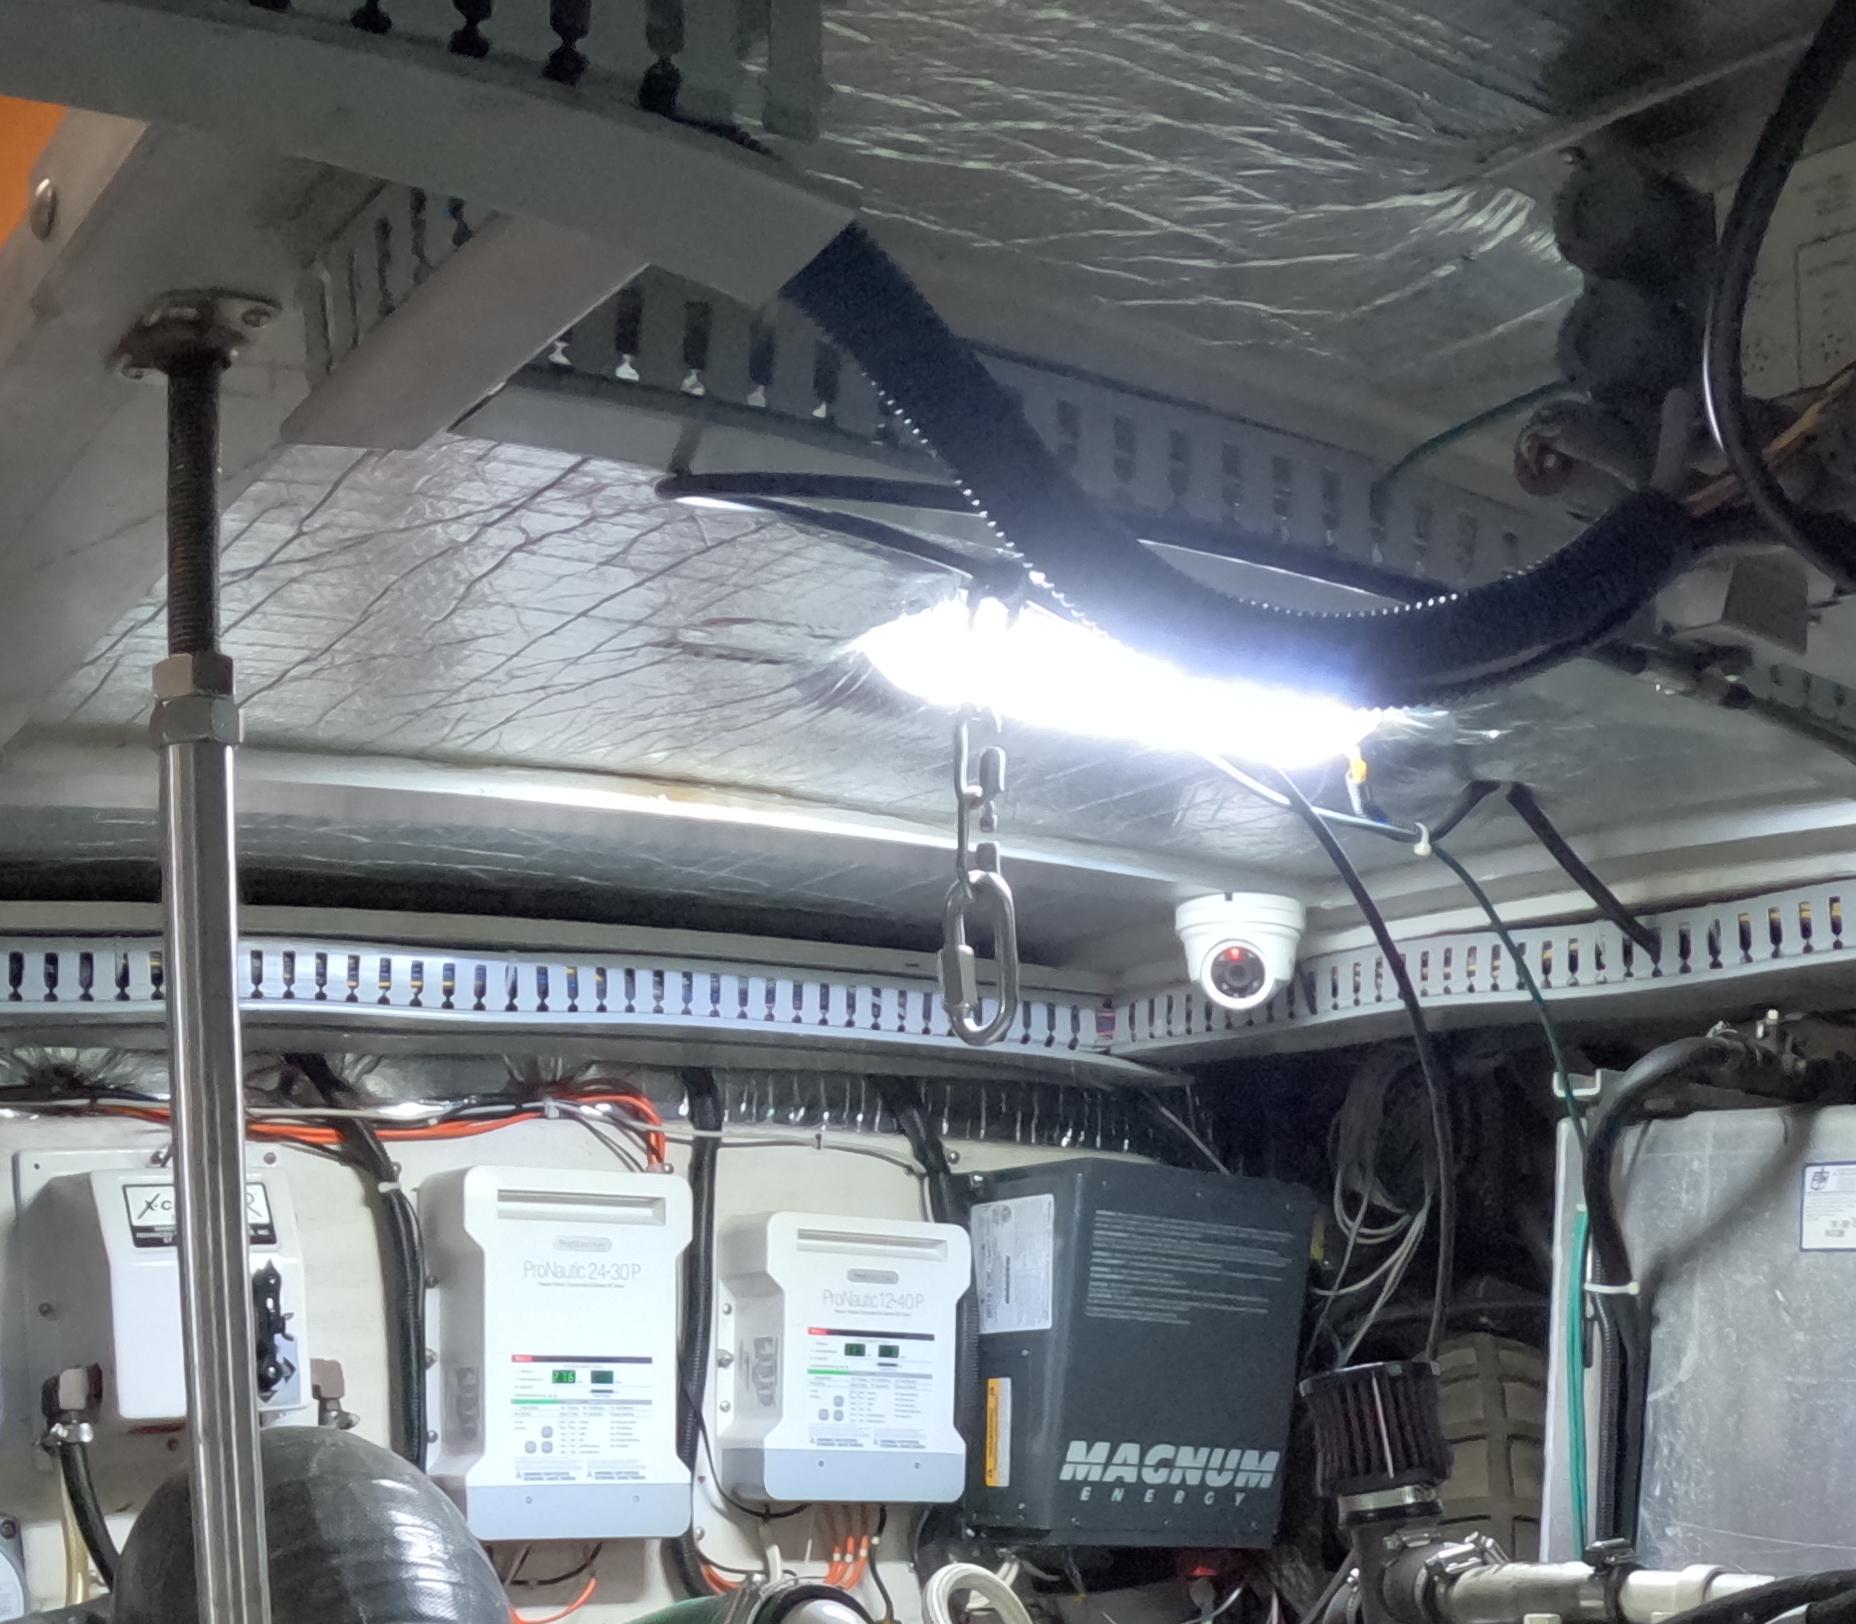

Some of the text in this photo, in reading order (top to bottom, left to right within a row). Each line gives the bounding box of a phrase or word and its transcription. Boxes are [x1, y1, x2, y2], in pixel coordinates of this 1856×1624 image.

[523, 1259, 585, 1279] ProNautic
[1059, 1440, 1280, 1489] MAGNUM
[1080, 1486, 1245, 1507] ENERGY
